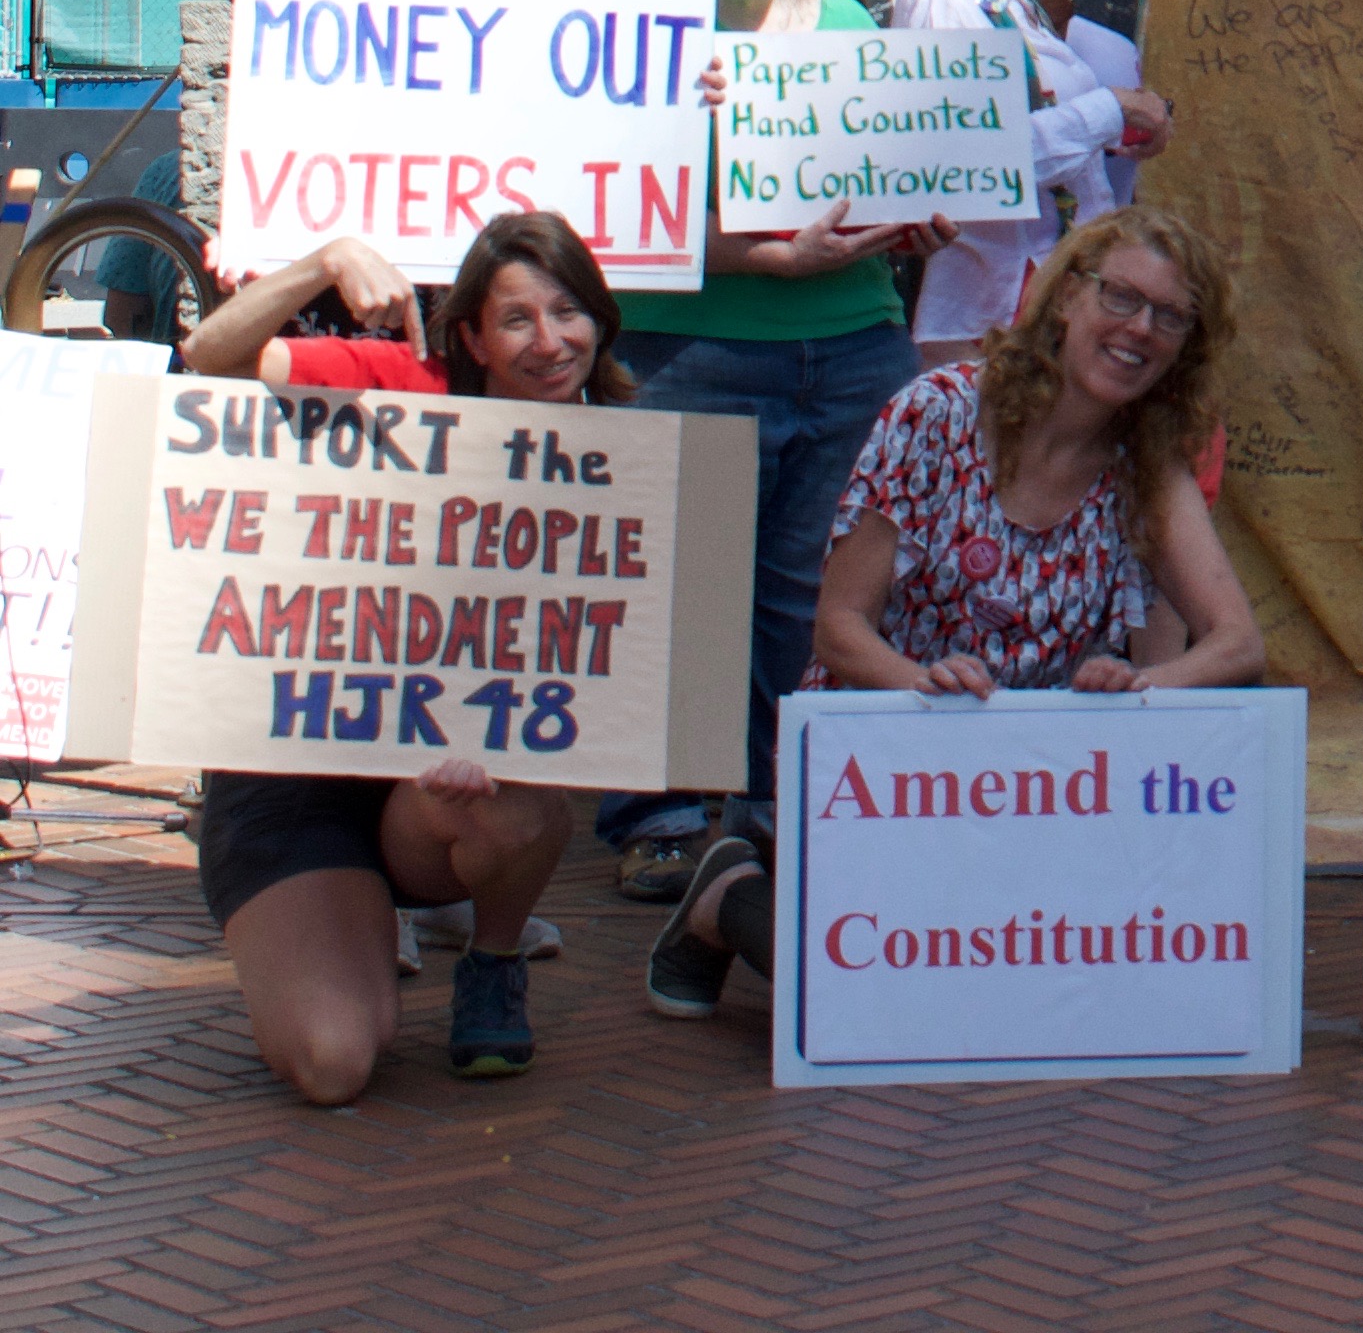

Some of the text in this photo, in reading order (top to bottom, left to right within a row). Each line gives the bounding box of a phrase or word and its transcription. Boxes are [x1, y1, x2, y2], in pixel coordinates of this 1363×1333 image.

[250, 0, 706, 107] MONEY OUT
[734, 37, 1012, 111] Paper Ballots
[732, 95, 1003, 139] Hand Counted
[582, 160, 692, 251] IN
[728, 153, 1024, 207] No Controversy
[167, 389, 613, 486] SUPPORT the
[163, 486, 648, 579] WE THE PEOPLE
[197, 575, 627, 678] AMENDMENT
[270, 670, 580, 753] HJR 48
[818, 750, 1238, 821] Amend the
[824, 906, 1250, 971] Constitution
